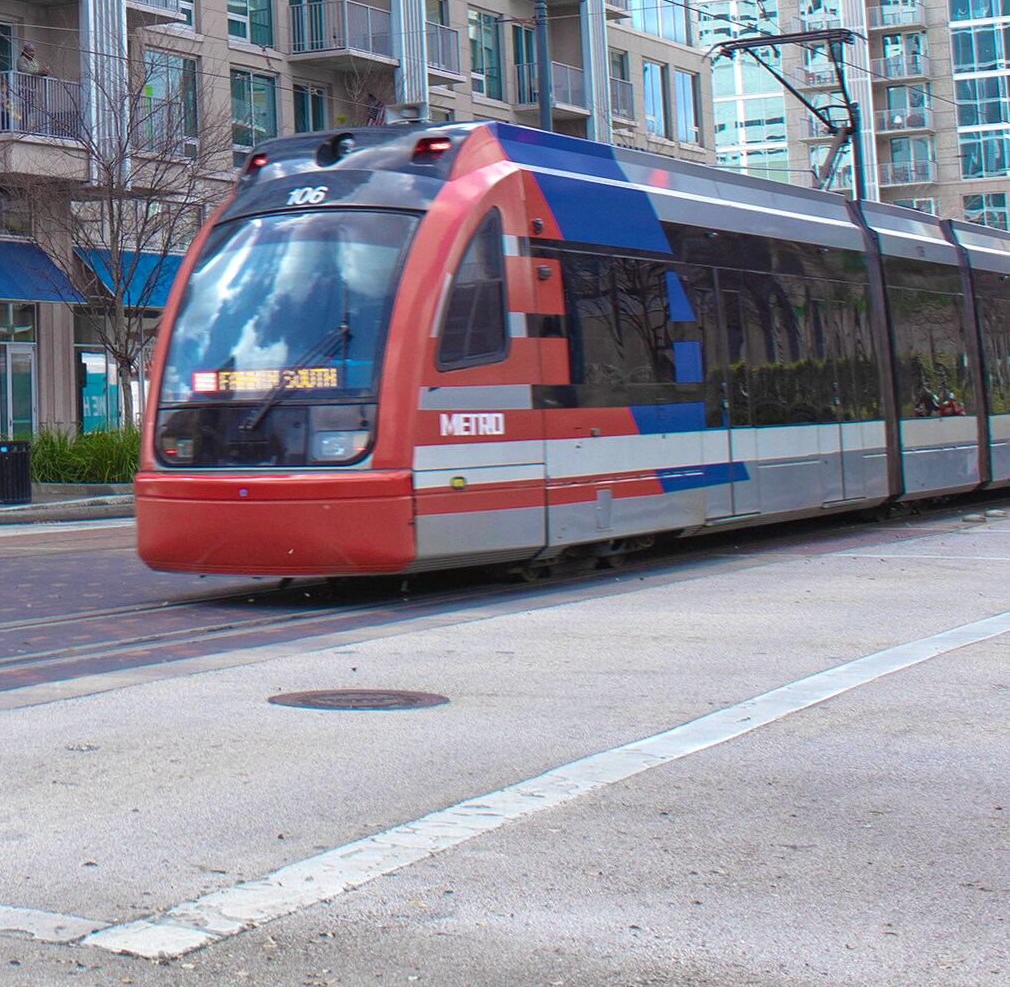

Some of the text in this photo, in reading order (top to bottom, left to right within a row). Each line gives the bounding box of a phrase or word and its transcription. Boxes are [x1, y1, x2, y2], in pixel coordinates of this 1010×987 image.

[286, 186, 329, 205] 106
[283, 367, 337, 388] SOUTH
[439, 413, 505, 436] METRO
